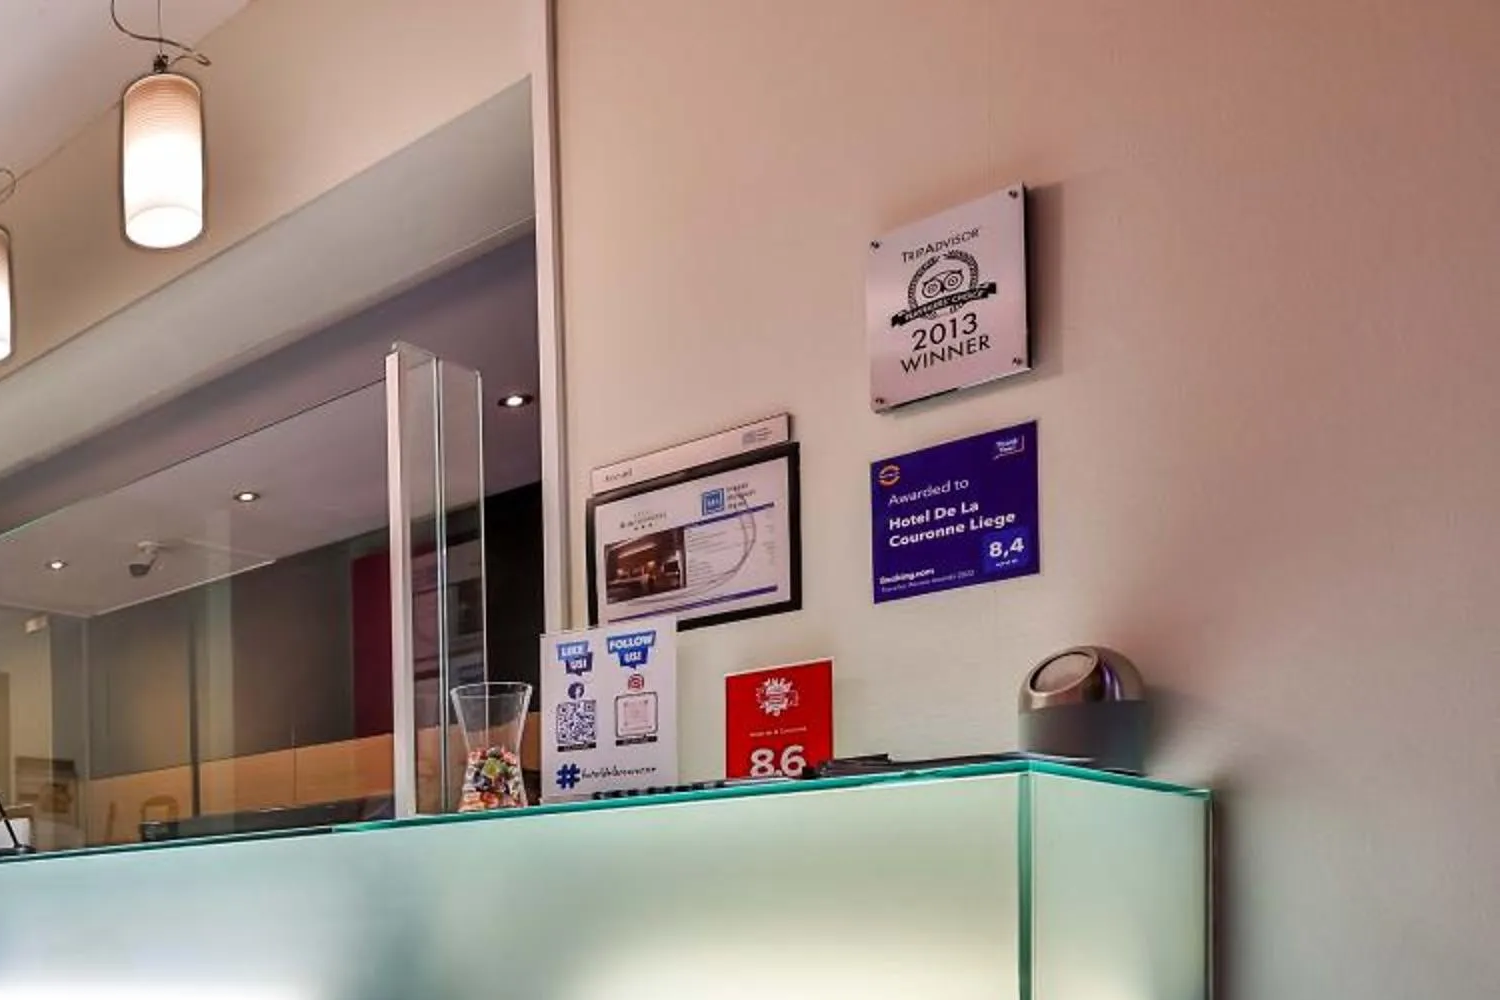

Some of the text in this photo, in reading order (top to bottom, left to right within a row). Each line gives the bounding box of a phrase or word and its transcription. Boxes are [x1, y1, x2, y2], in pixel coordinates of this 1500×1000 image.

[902, 228, 980, 262] TRIPADVISOR
[912, 313, 978, 351] 2013
[900, 335, 991, 373] WINNER
[888, 478, 969, 504] Awarded to
[889, 501, 979, 531] Hotel De La
[889, 512, 1016, 548] Couronne Liege
[989, 537, 1025, 559] 8,4
[609, 636, 652, 652] FOLLOW
[750, 745, 807, 777] 8.6
